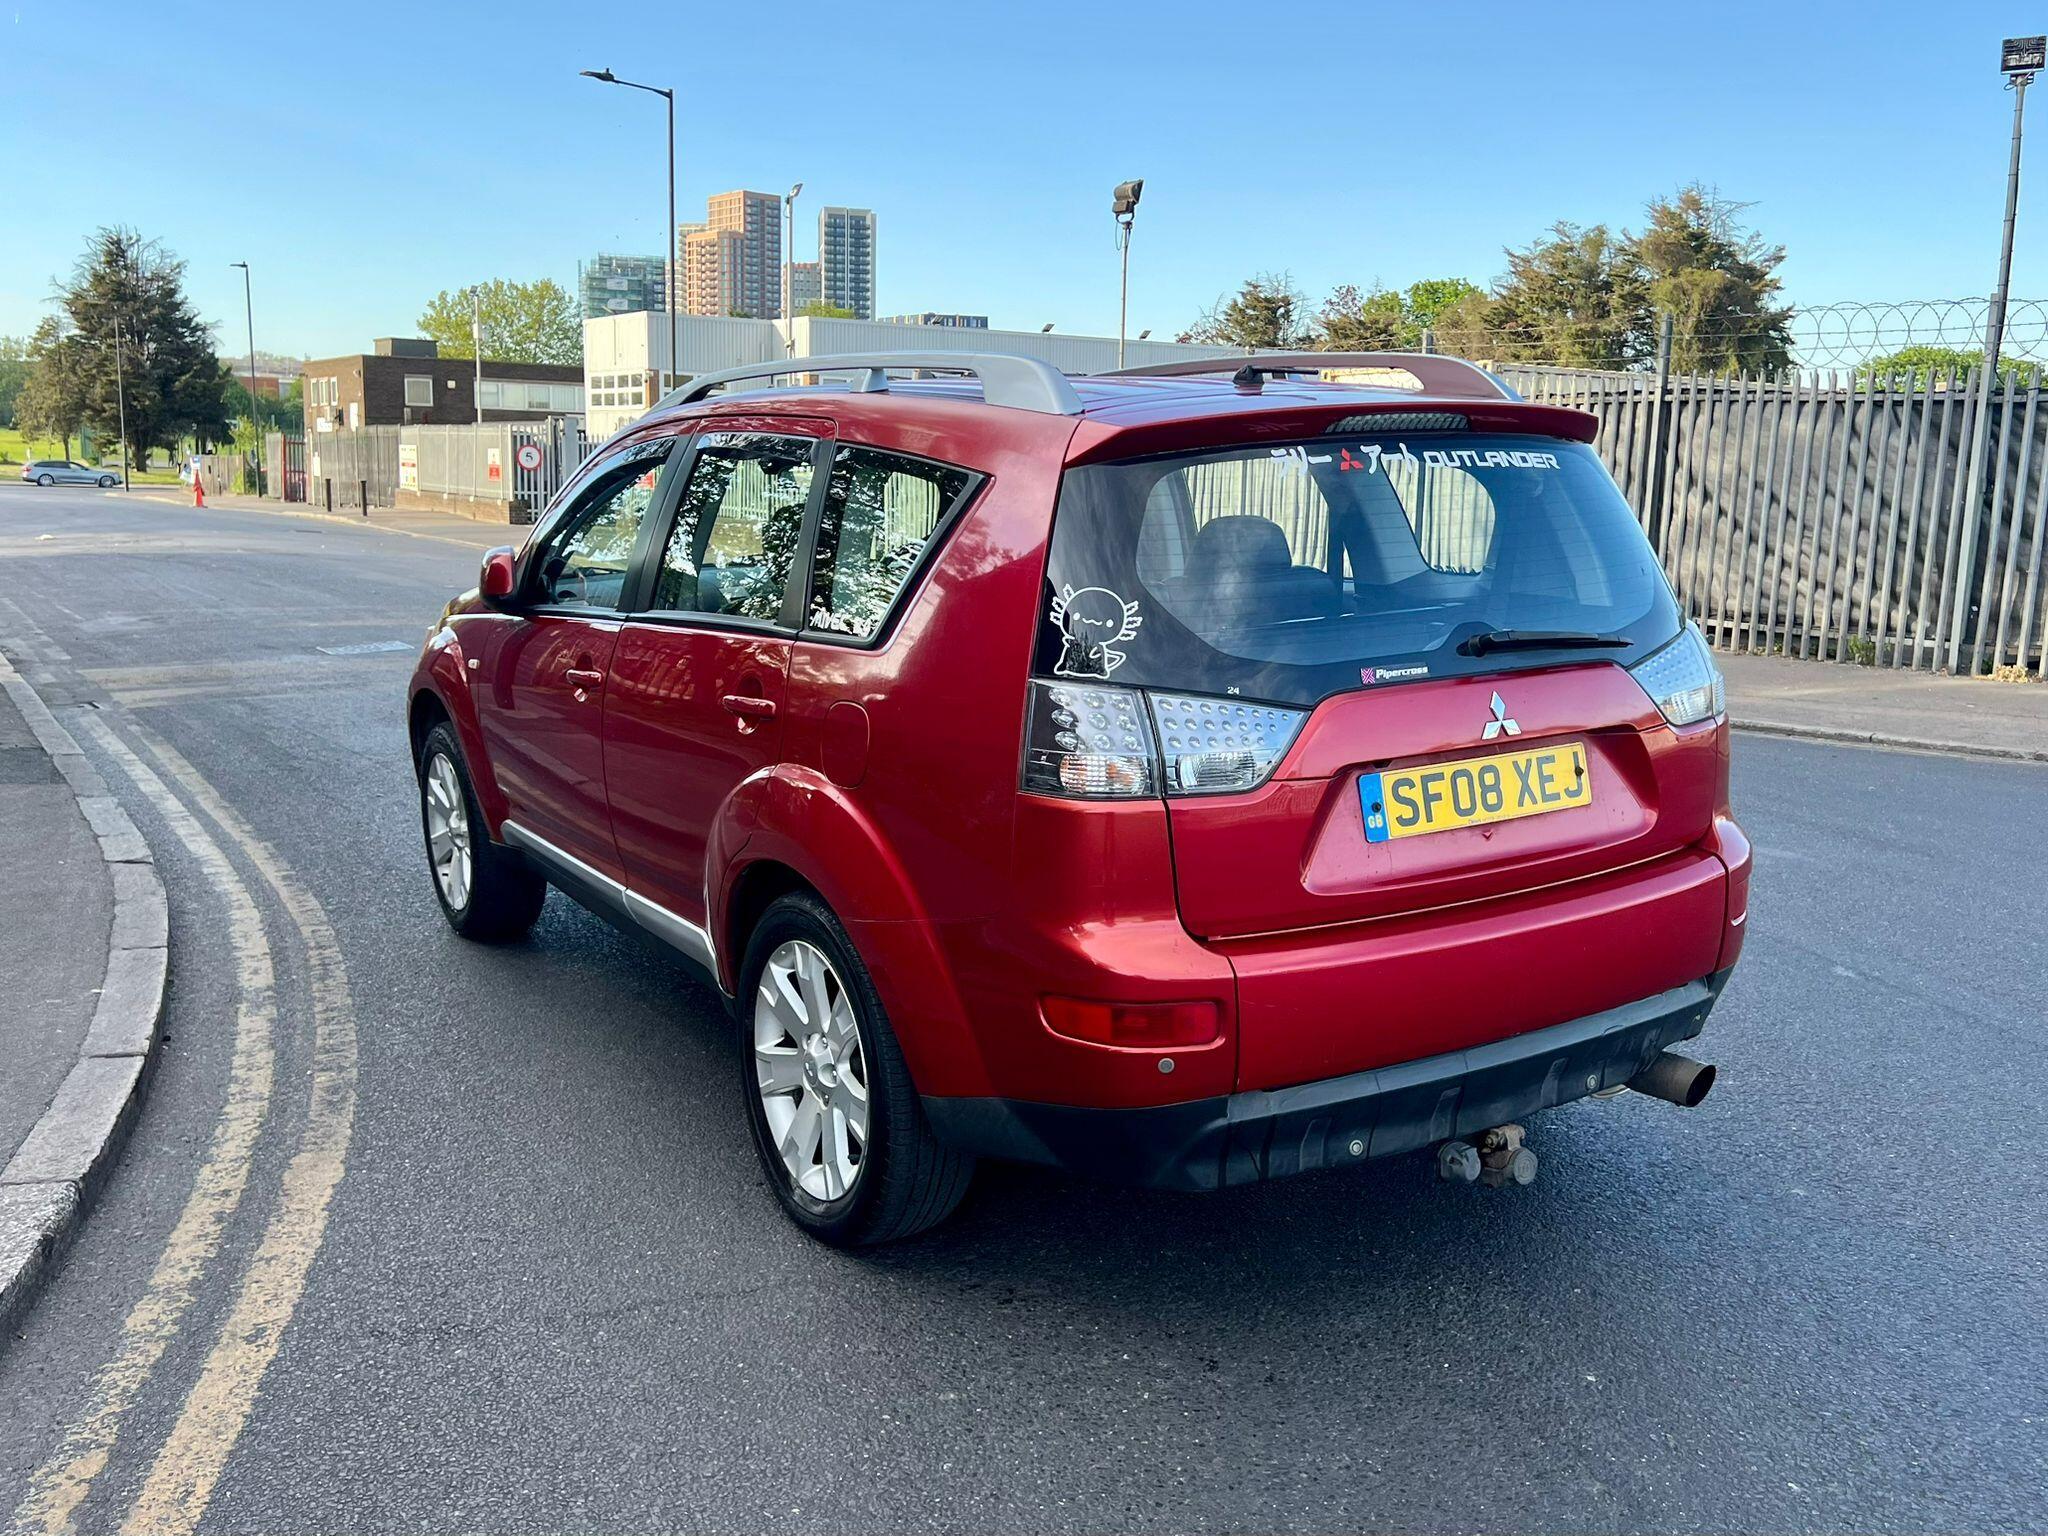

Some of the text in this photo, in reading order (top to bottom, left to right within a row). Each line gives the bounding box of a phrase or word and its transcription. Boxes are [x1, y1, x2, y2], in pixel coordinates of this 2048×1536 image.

[1422, 450, 1561, 470] OUTLANDER
[1376, 665, 1428, 680] Pipercross
[1227, 686, 1240, 696] 24
[1391, 751, 1584, 827] SF08 XEJ
[1367, 814, 1384, 829] GB
